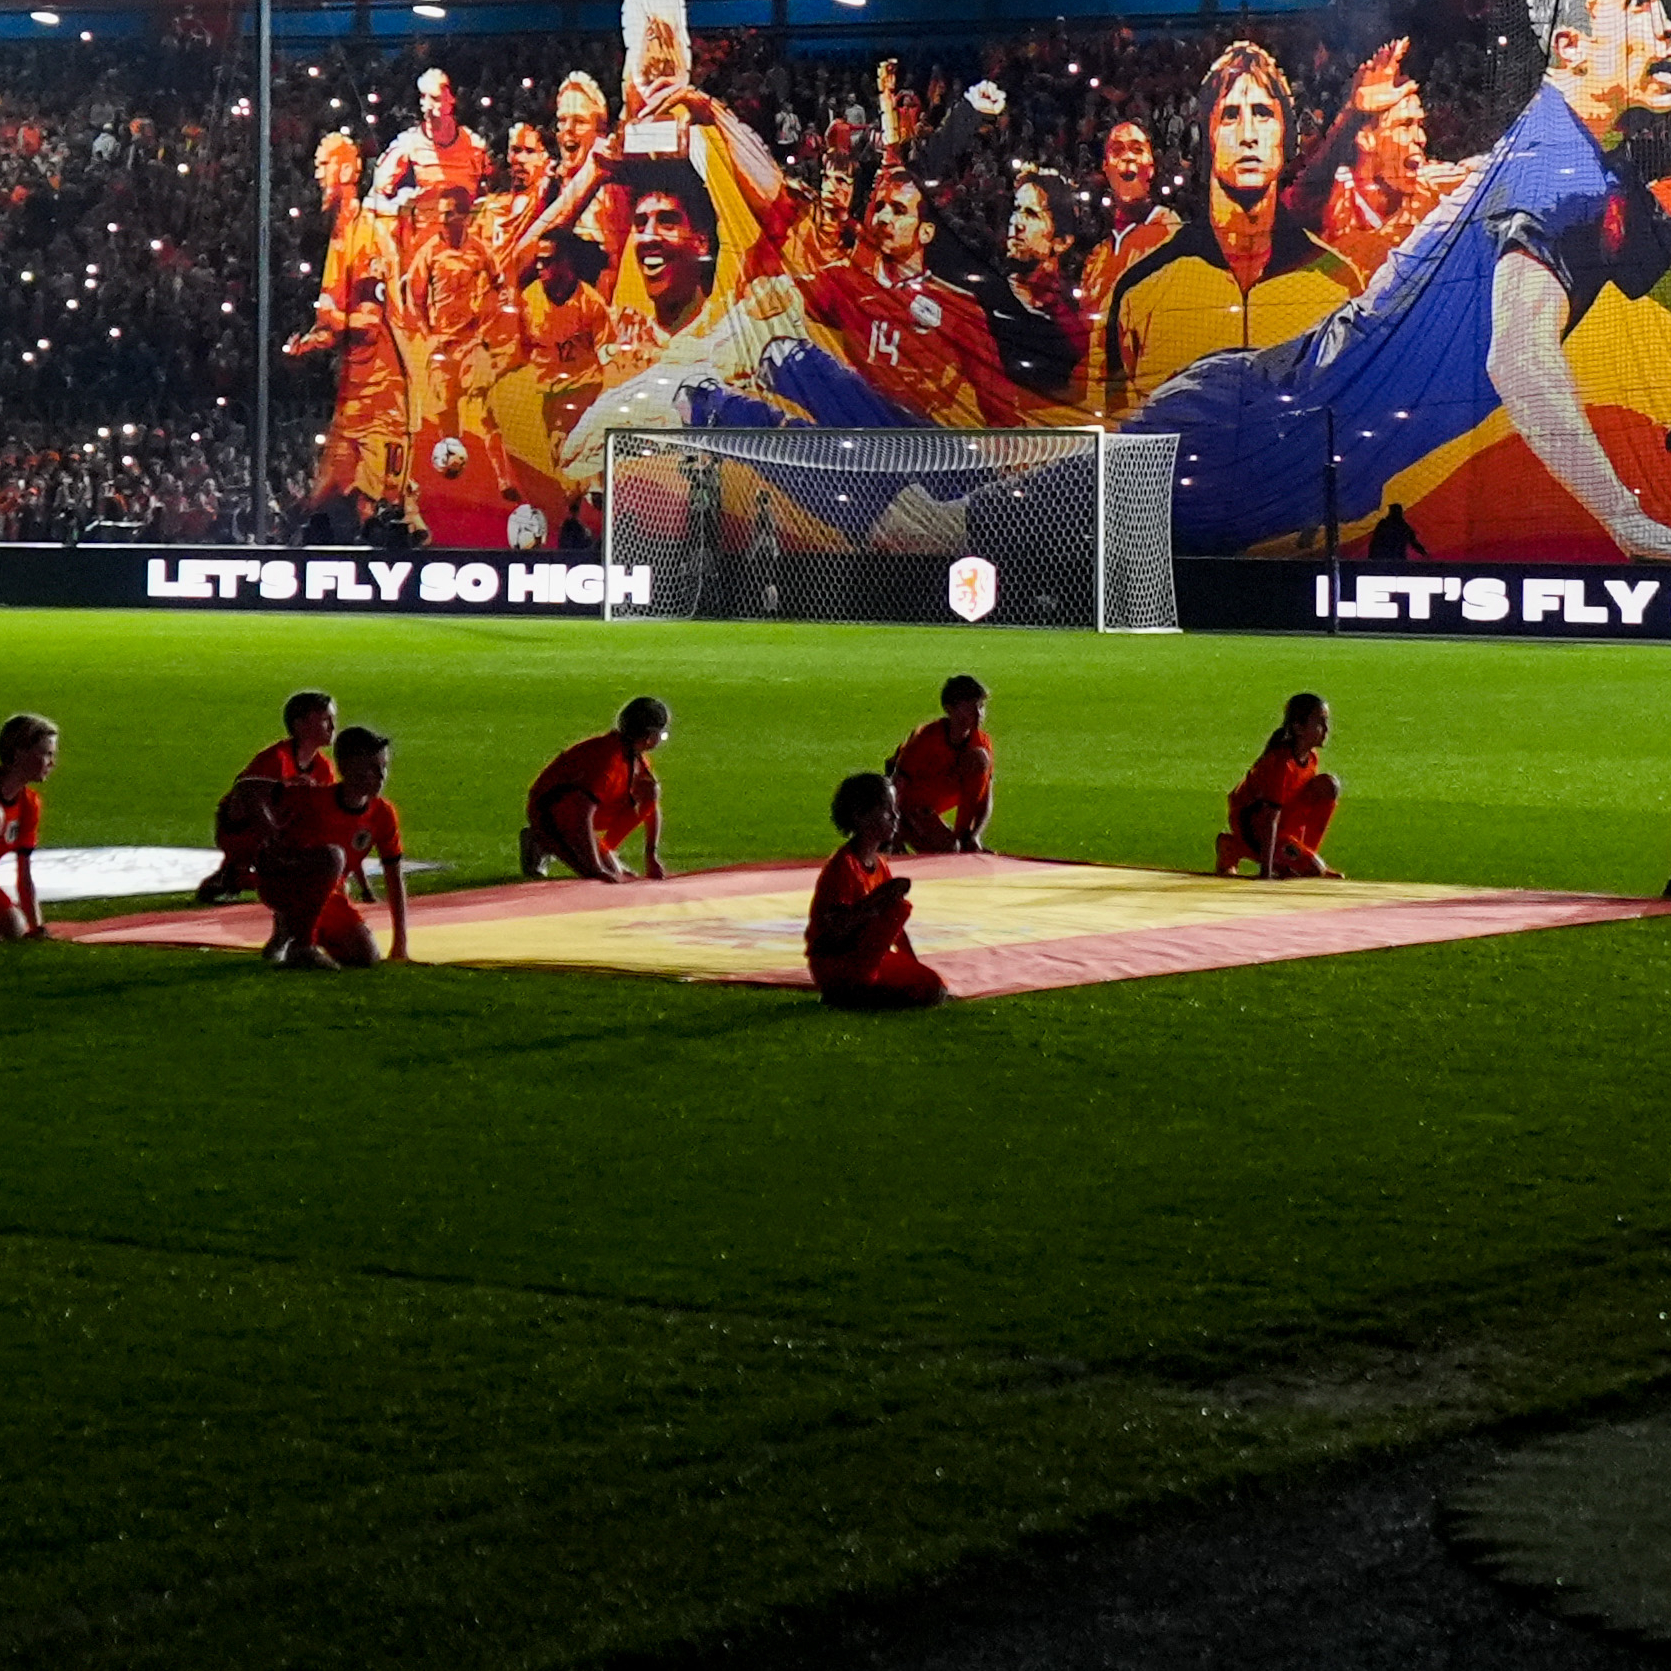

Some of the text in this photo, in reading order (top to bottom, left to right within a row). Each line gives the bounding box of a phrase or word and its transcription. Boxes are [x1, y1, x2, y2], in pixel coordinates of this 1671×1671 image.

[867, 320, 900, 366] 14
[147, 558, 650, 606] LET'S FLY SO HIGH
[1316, 574, 1509, 622] LET'S
[1522, 579, 1659, 624] FLY
